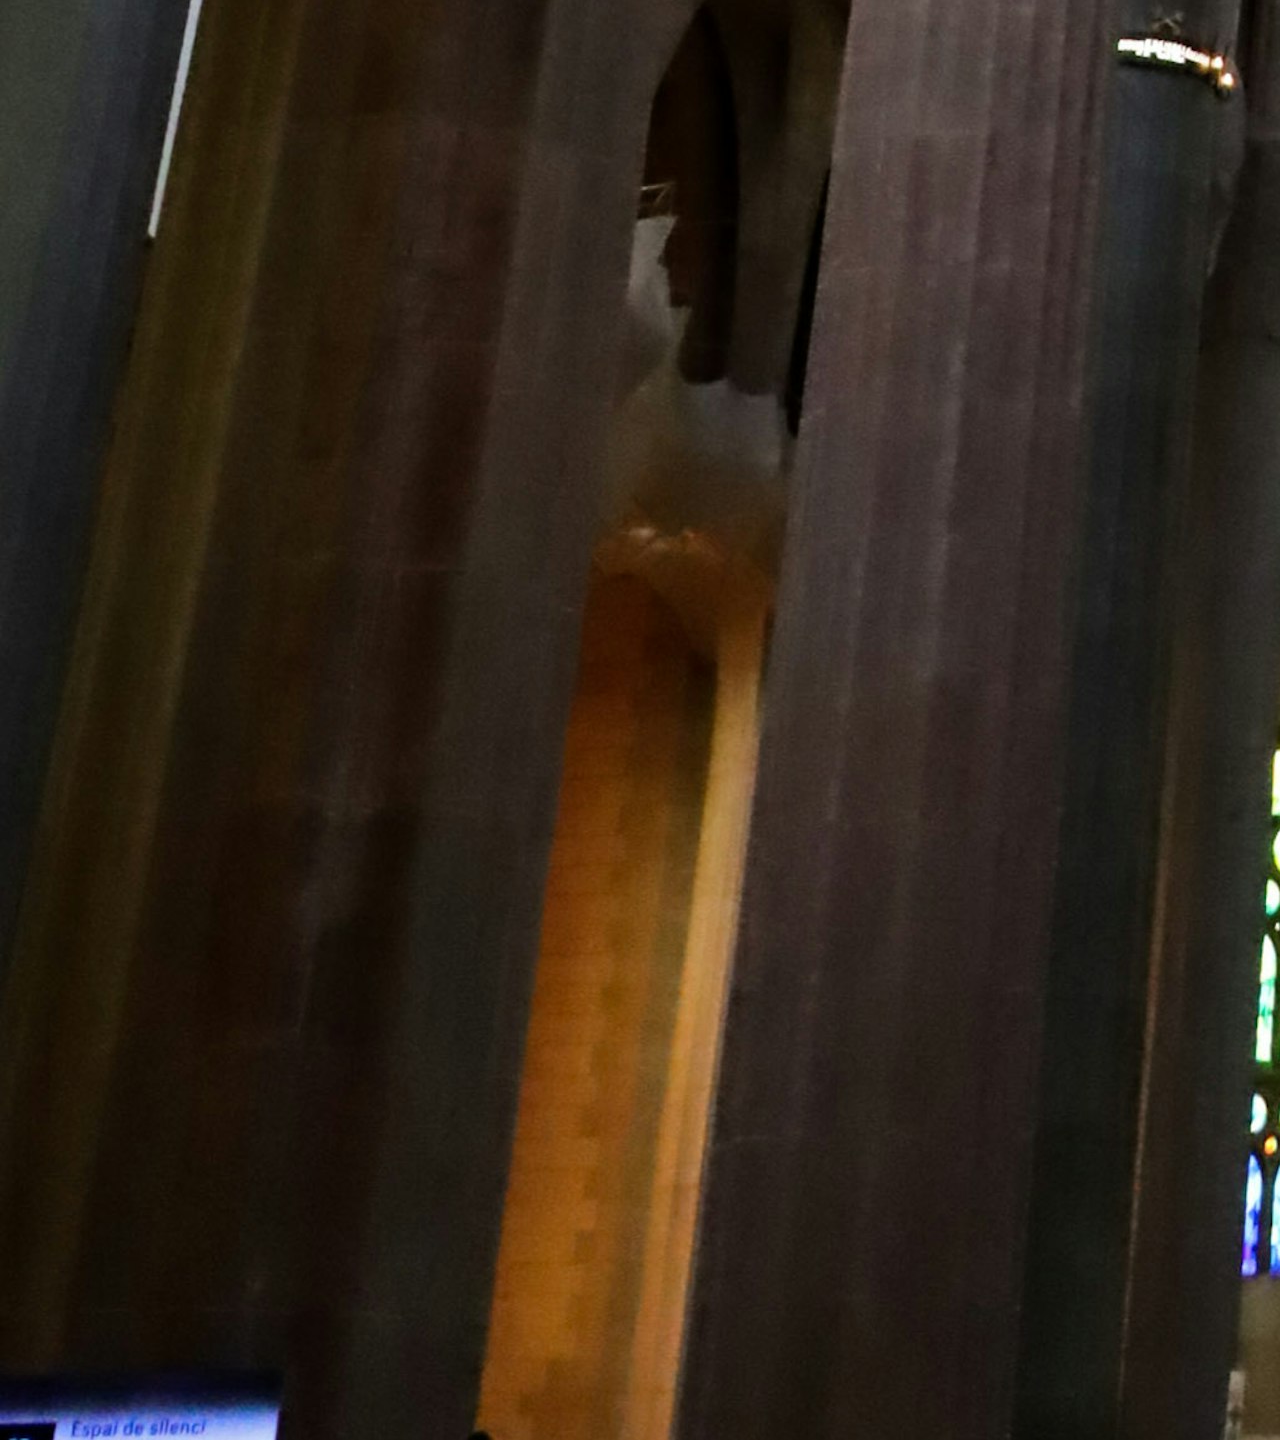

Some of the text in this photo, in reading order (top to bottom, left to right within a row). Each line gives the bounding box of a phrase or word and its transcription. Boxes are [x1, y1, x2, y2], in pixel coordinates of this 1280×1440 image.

[71, 1416, 207, 1440] Espai de silenci
